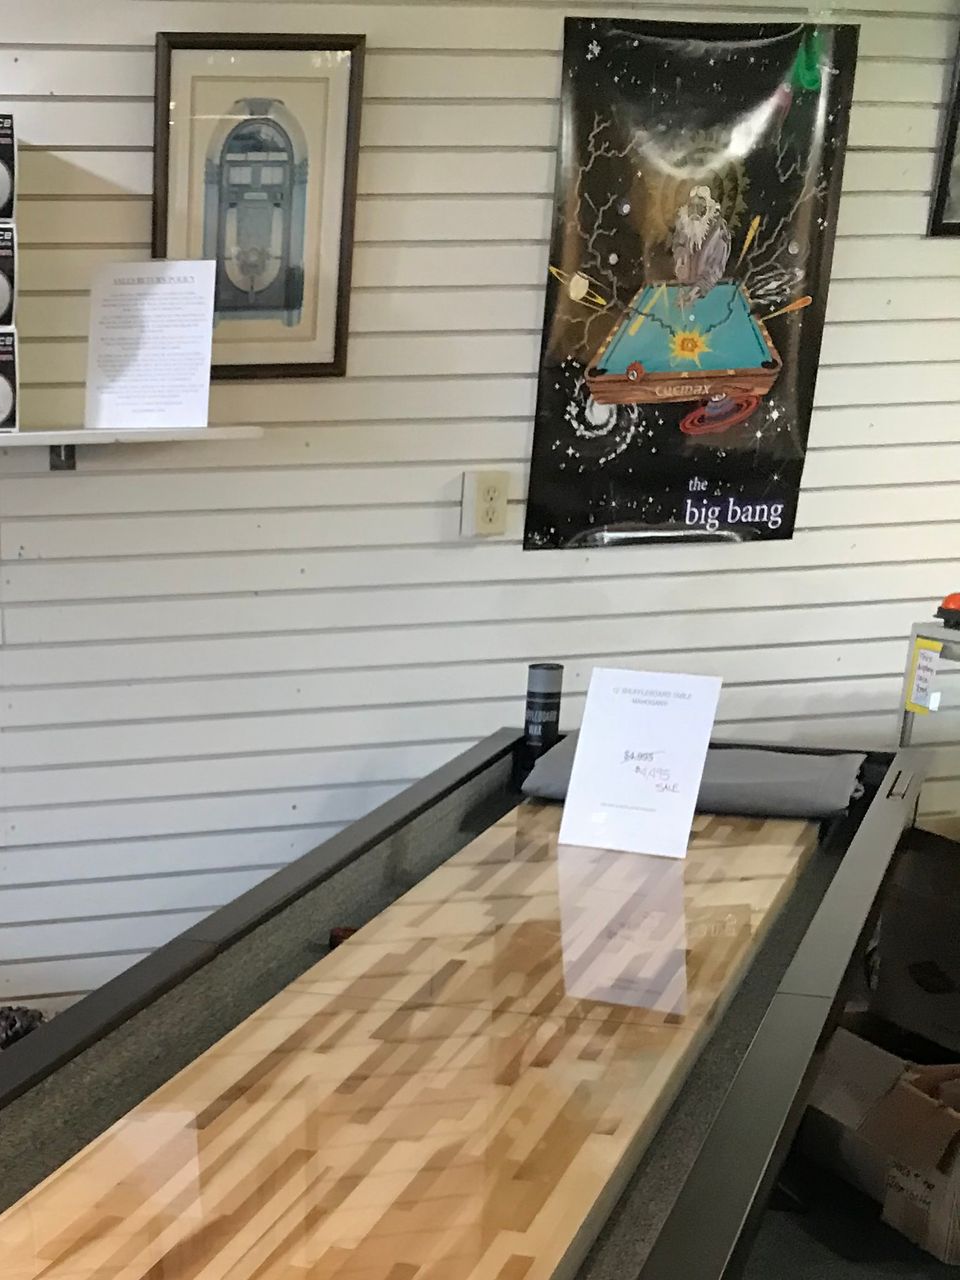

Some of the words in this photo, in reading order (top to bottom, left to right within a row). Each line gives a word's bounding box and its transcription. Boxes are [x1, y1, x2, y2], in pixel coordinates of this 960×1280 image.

[689, 476, 709, 492] the
[685, 499, 721, 532] big
[727, 498, 784, 529] bang
[655, 783, 680, 793] SALE
